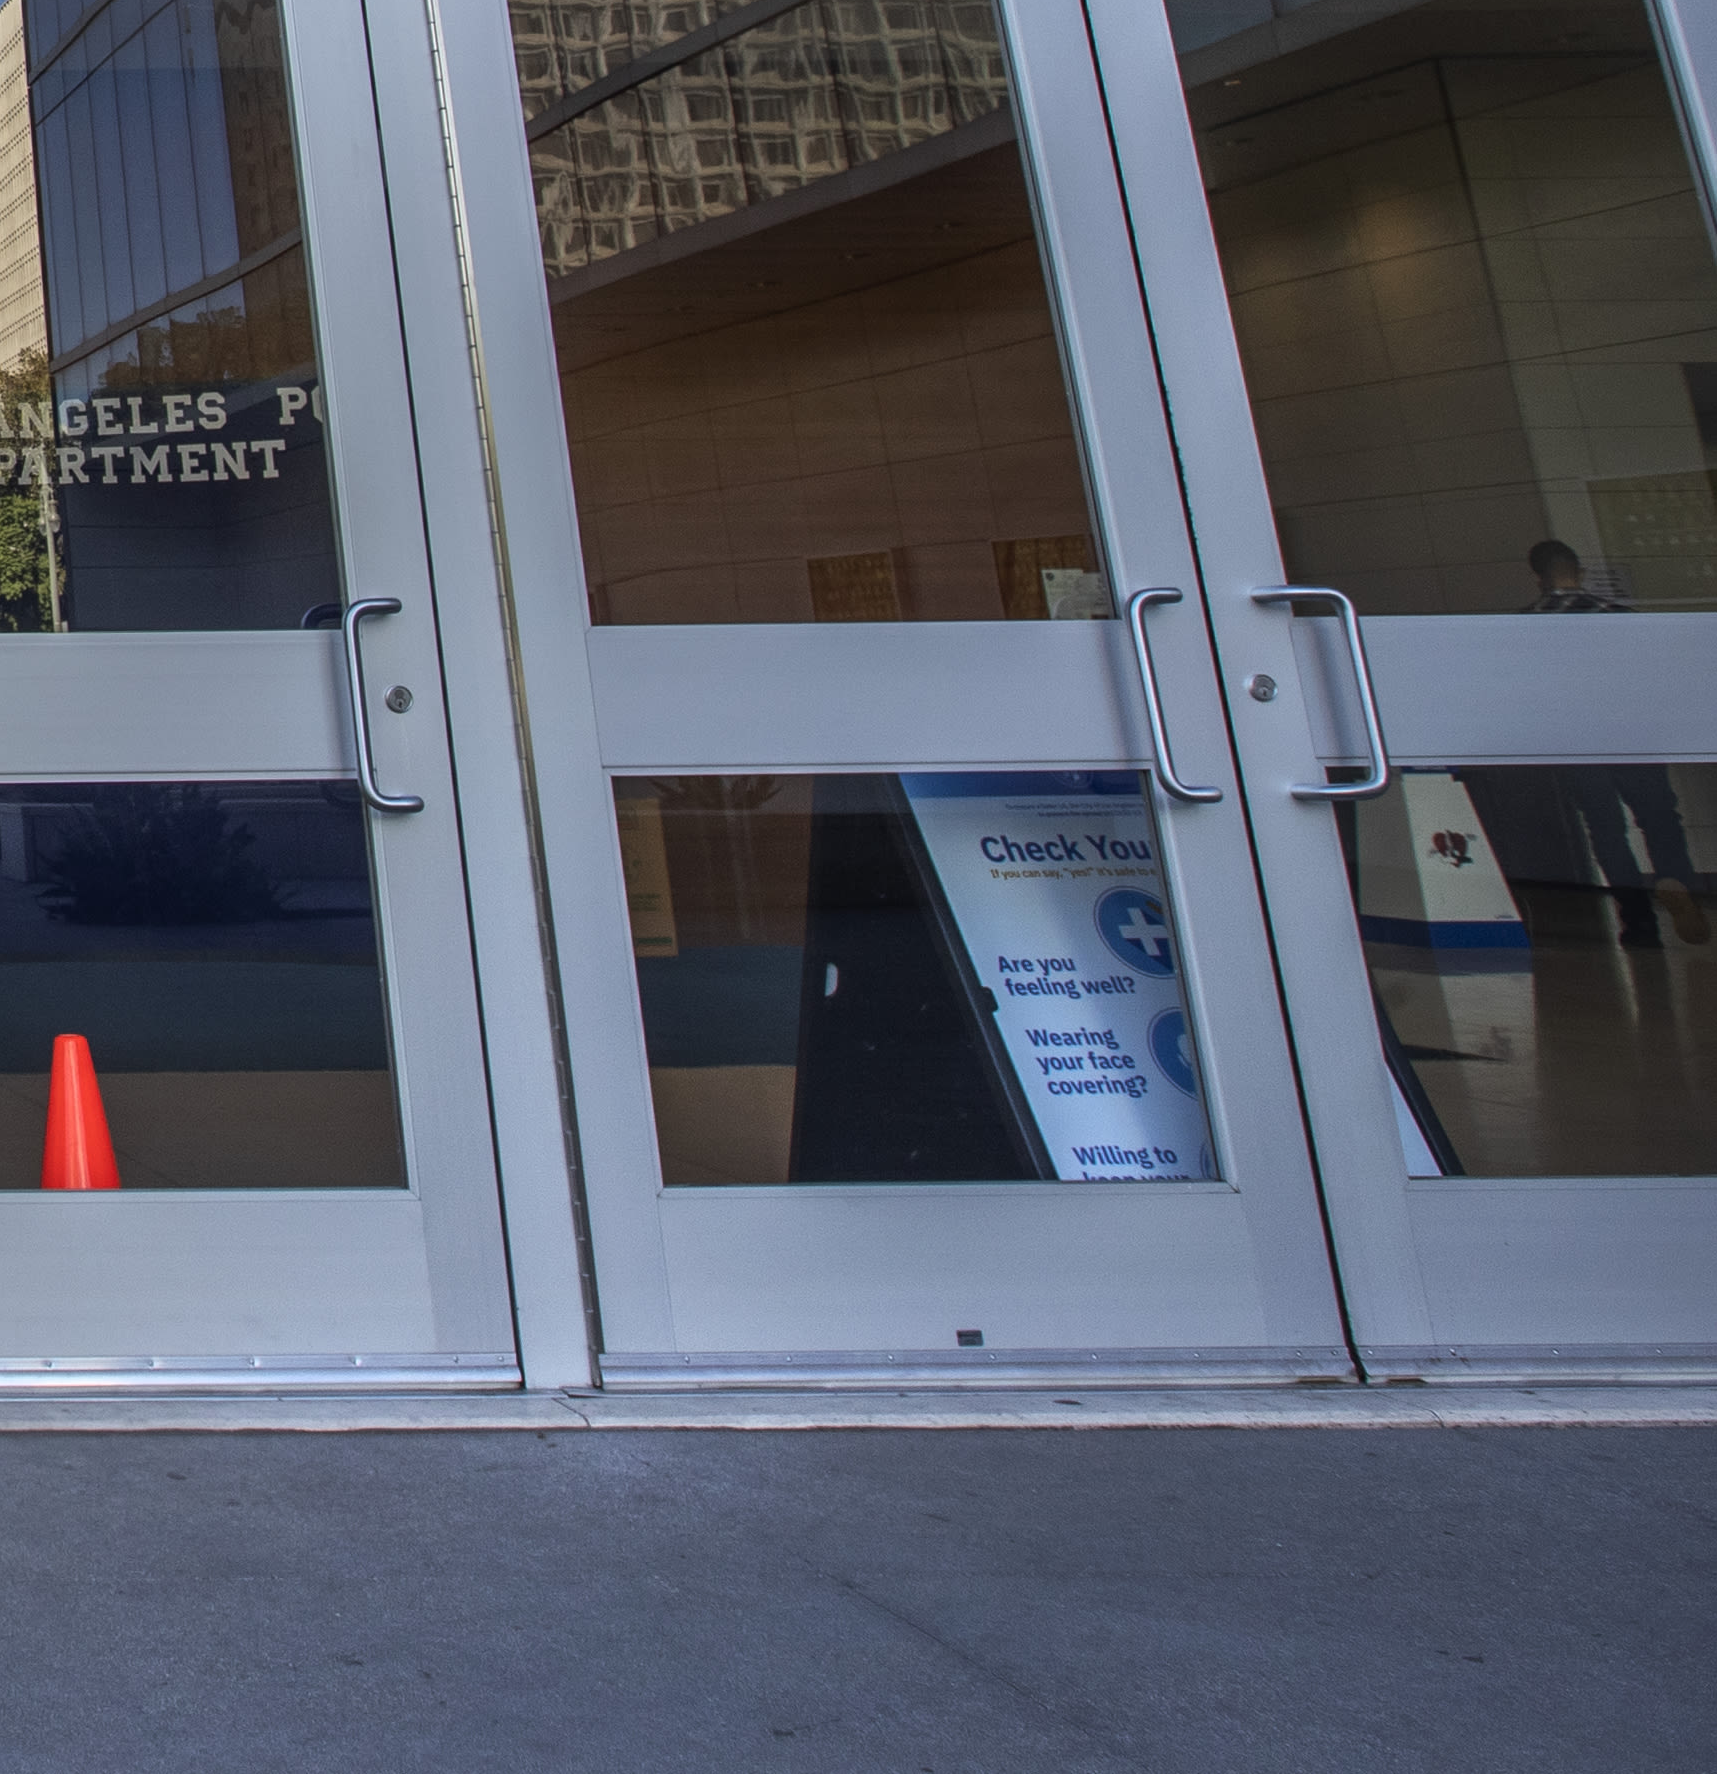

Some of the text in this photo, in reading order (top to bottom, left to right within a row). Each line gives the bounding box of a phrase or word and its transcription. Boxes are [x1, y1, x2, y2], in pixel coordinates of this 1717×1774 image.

[980, 834, 1086, 863] Check
[998, 955, 1076, 977] Are you
[1005, 976, 1136, 1000] feeling well?
[1026, 1027, 1120, 1049] Wearing
[1036, 1052, 1135, 1075] your face
[1047, 1075, 1148, 1098] covering?
[1072, 1146, 1177, 1169] Willing to
